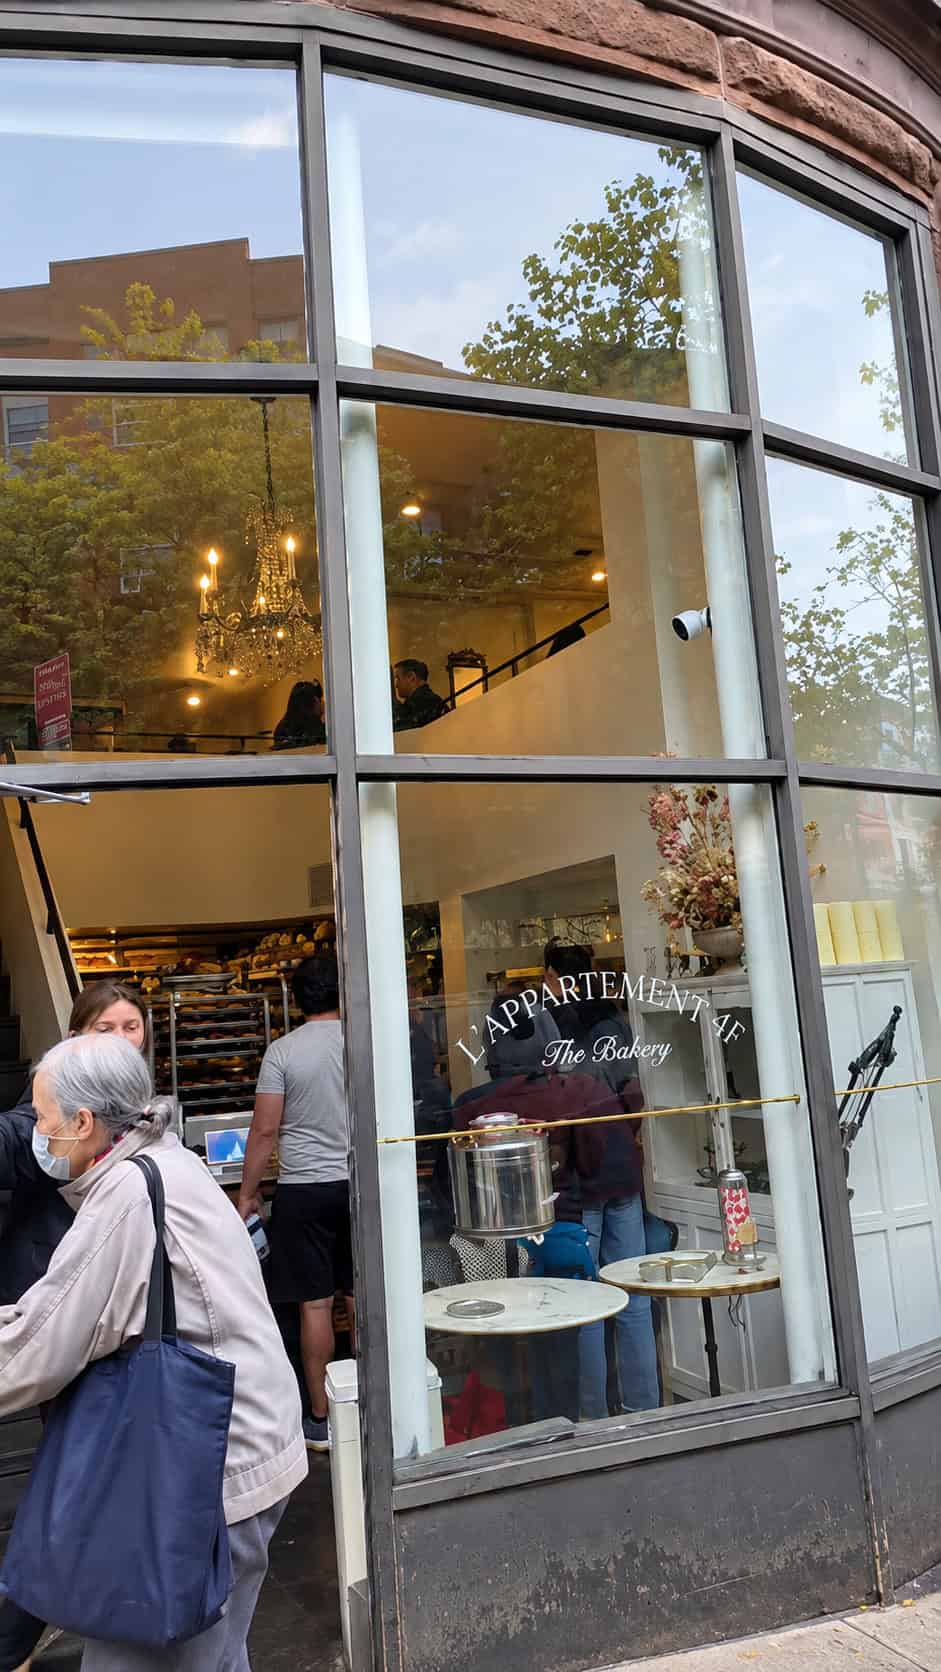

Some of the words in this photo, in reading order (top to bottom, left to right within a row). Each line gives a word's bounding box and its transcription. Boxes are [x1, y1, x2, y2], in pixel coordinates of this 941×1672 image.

[456, 971, 710, 1065] L'APPARTEMENT
[712, 1013, 746, 1043] 4F
[542, 1038, 586, 1067] The
[592, 1035, 672, 1067] Bakery
